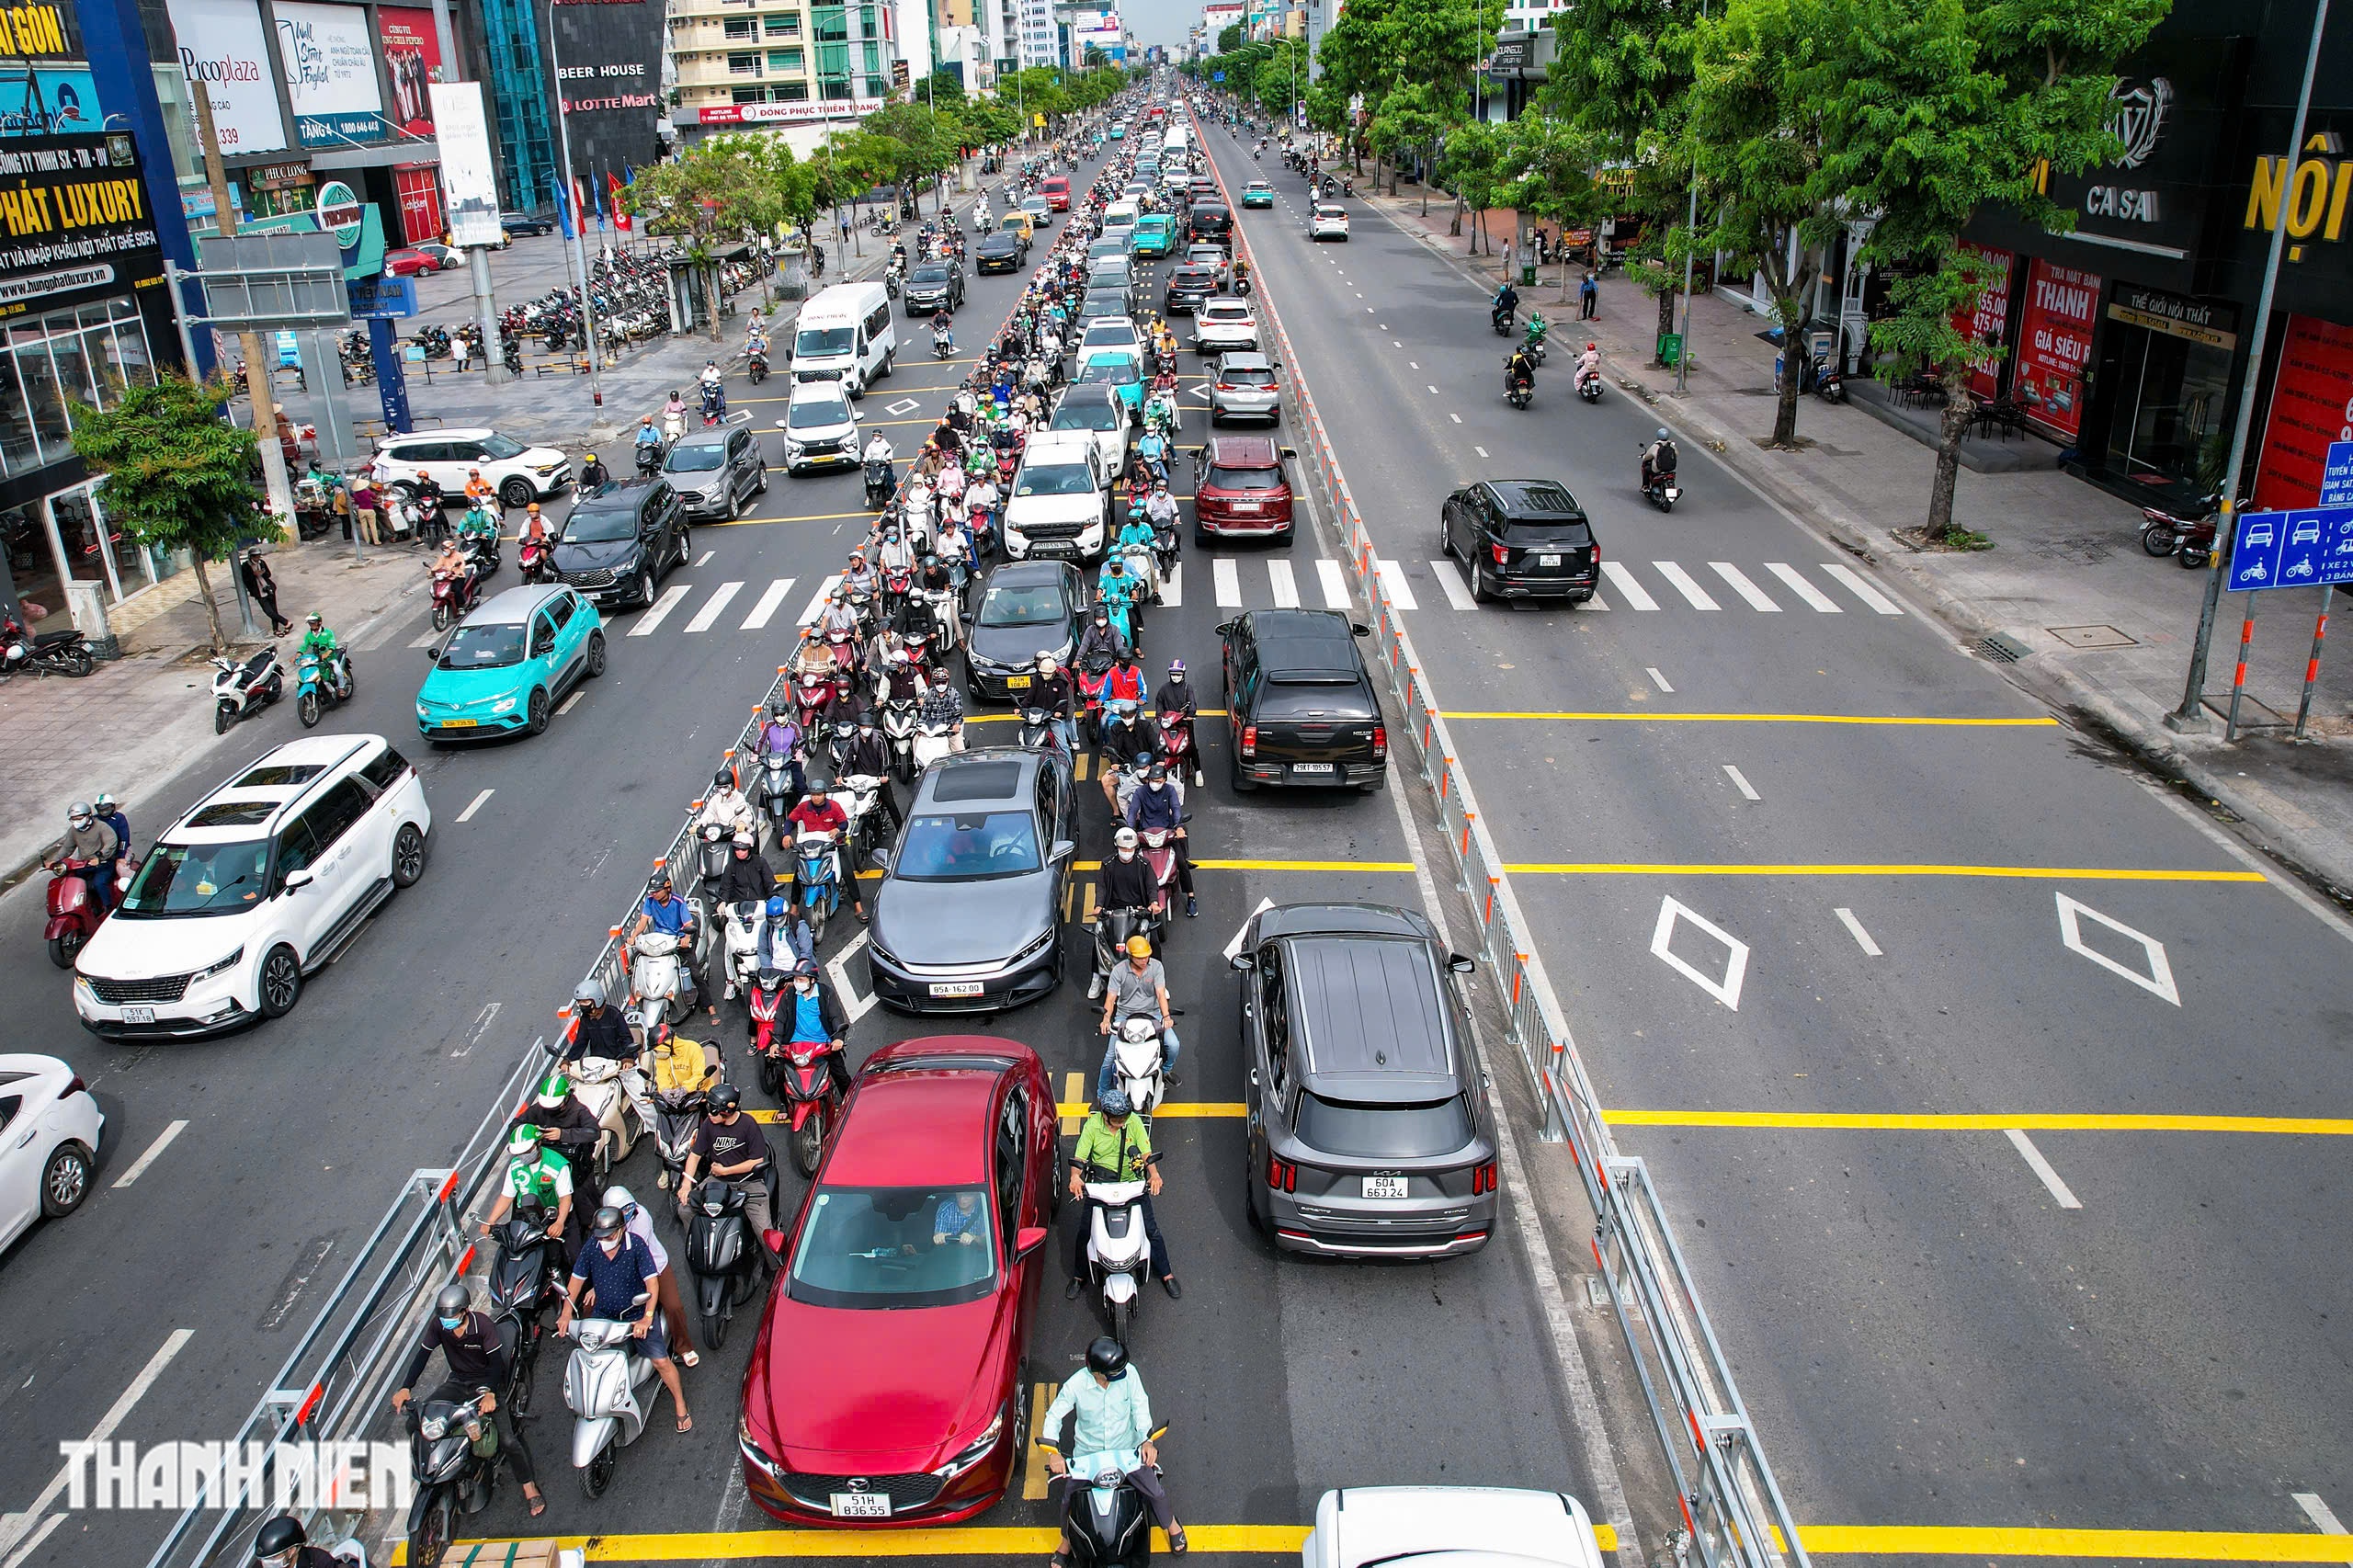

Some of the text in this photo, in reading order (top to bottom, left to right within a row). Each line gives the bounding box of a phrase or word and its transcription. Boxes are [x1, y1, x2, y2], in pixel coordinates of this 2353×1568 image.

[296, 21, 314, 42] Wall
[301, 42, 323, 63] Street
[179, 47, 259, 89] Picoplaza
[558, 64, 644, 79] BEER HOUSE
[302, 65, 330, 90] English
[574, 94, 656, 111] LOTTE Mart
[790, 106, 815, 117] PHỤC
[817, 103, 845, 113] THIÊN
[847, 103, 880, 112] TRANG
[341, 122, 356, 133] 1800
[32, 150, 60, 172] TNHH
[58, 150, 74, 170] SX
[76, 149, 93, 168] TM
[287, 164, 307, 177] LONG
[52, 178, 142, 229] LUXURY
[2086, 187, 2155, 222] CASA
[2244, 133, 2353, 262] NỘI
[135, 230, 157, 247] SOFA
[380, 285, 404, 299] NAM
[2036, 279, 2090, 321] THANH
[2131, 292, 2150, 310] THẾ
[2167, 301, 2184, 320] NỘI
[2034, 328, 2053, 352] GIÁ
[2054, 335, 2081, 361] SIÊU
[715, 1136, 737, 1148] NIKE
[1375, 1178, 1395, 1187] 60A
[1367, 1187, 1403, 1198] 663.24
[851, 1495, 875, 1506] 51H
[844, 1506, 885, 1516] 836.55
